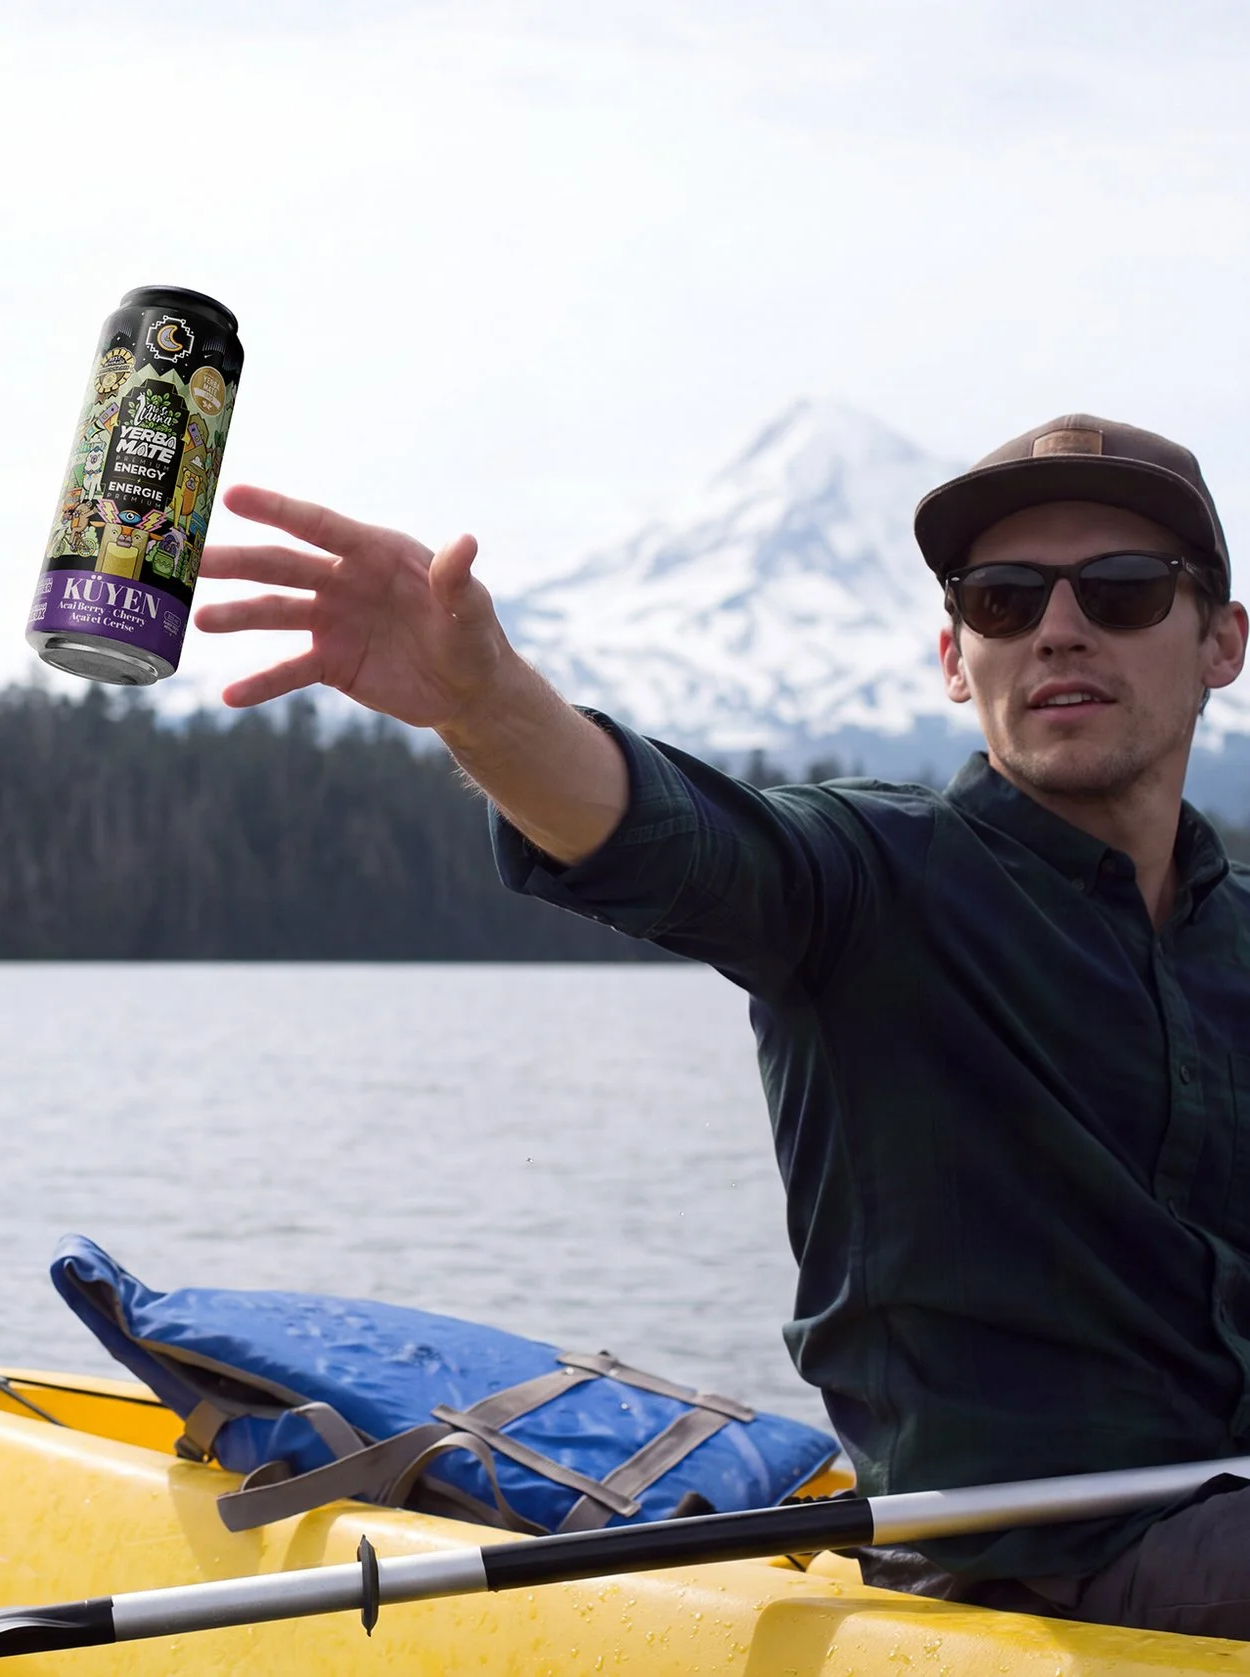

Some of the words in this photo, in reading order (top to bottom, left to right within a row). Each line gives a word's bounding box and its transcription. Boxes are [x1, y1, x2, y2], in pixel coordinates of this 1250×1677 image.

[120, 425, 177, 450] YERBA
[116, 439, 176, 464] MATE
[114, 462, 166, 481] ENERGY
[116, 455, 170, 471] PREMIUM
[106, 492, 161, 508] PREMIUM
[108, 481, 163, 502] ENERGIE
[63, 575, 161, 619] KÜYEN
[78, 602, 105, 616] Berry
[112, 608, 146, 626] Cherry
[91, 614, 102, 624] et
[102, 617, 135, 633] Cerise
